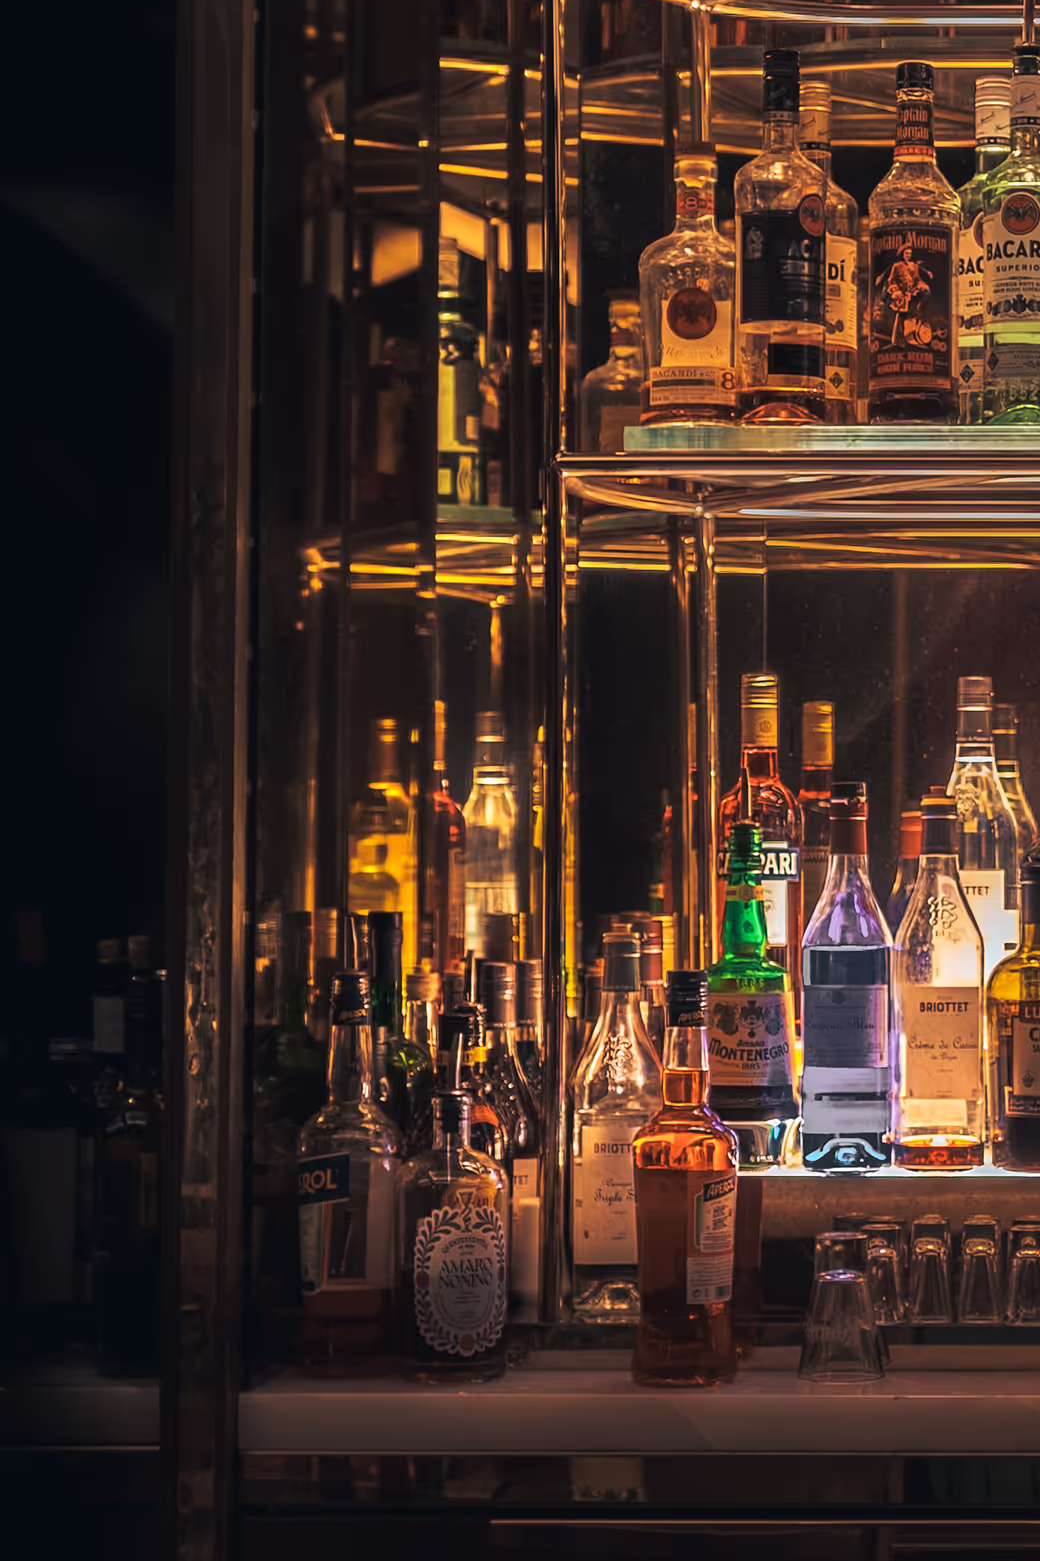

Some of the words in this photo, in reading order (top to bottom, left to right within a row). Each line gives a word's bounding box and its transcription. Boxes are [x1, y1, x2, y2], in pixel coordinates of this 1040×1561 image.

[721, 371, 736, 391] 8
[919, 1001, 969, 1013] BRIOTTET
[708, 1038, 790, 1063] MONTENEGRO
[593, 1143, 634, 1155] BRIOTT
[706, 1178, 735, 1200] APEROL
[440, 1257, 493, 1274] AMARO
[440, 1272, 493, 1289] NONINO
